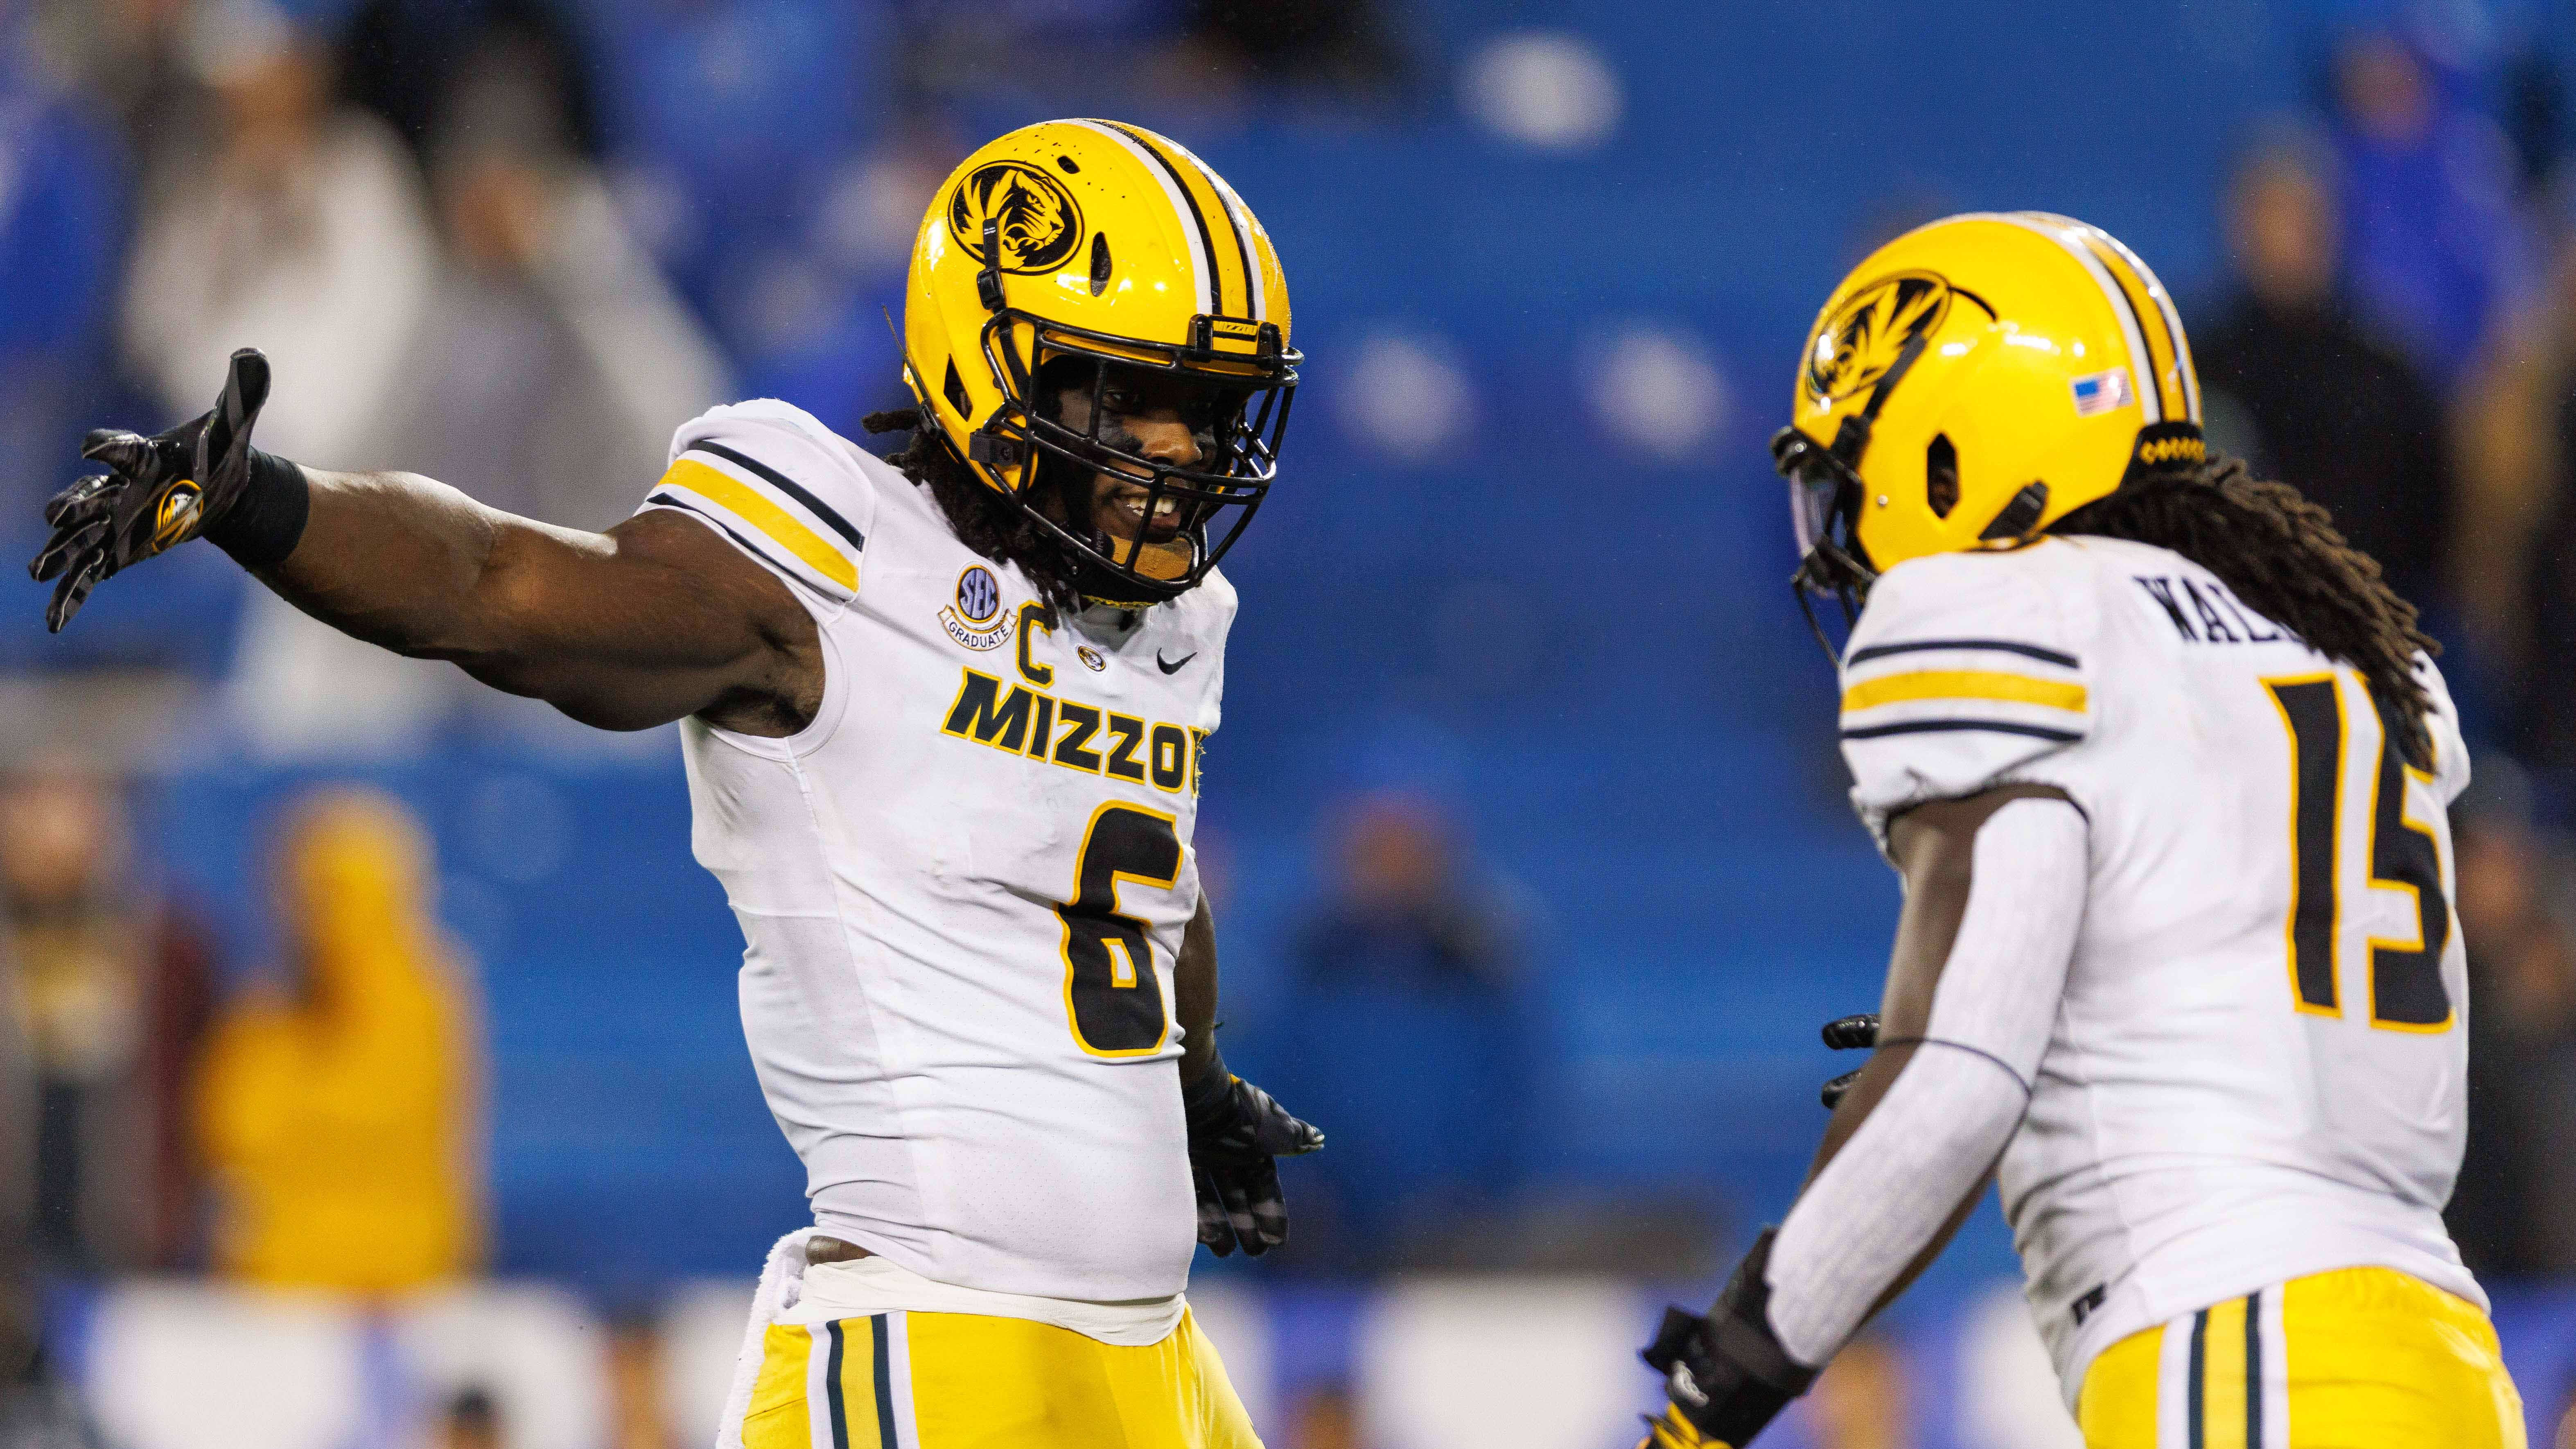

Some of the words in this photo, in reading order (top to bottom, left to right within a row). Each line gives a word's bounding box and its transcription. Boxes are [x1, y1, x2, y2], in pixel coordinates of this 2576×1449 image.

[960, 568, 997, 618] SEC
[2132, 574, 2304, 644] WAL
[948, 621, 1009, 647] GRADUATE
[1016, 600, 1055, 689] C
[2258, 669, 2456, 1033] 15
[1053, 800, 1184, 1058] 6
